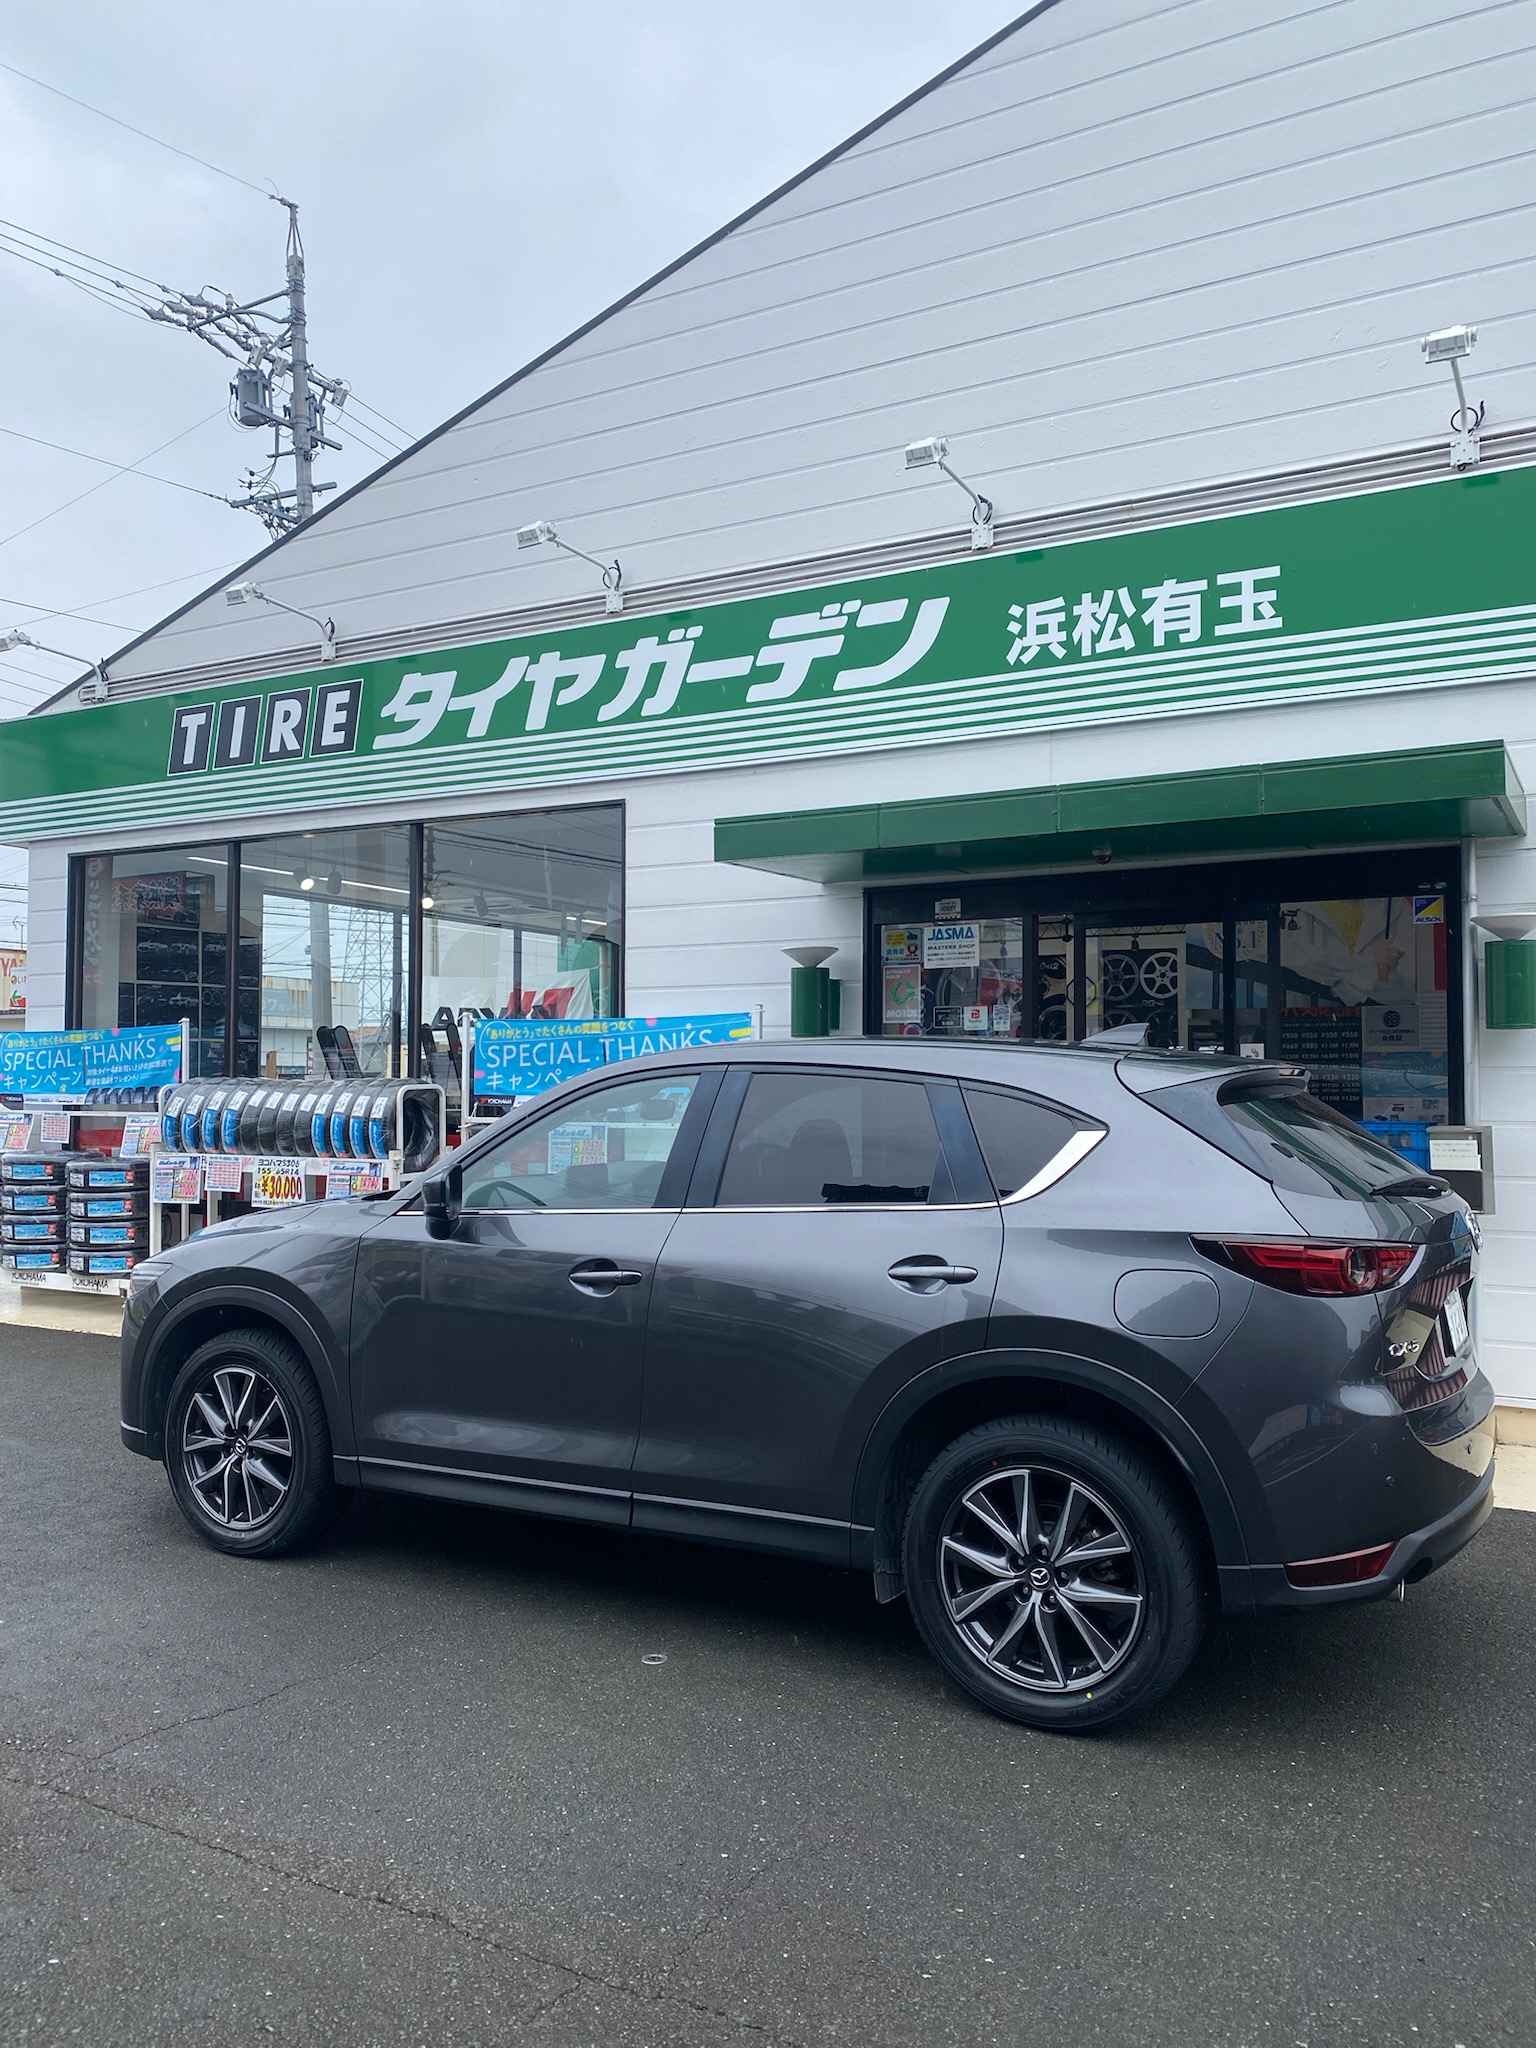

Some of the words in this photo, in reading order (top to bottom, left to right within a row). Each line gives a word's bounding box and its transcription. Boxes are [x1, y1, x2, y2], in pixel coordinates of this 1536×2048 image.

[180, 689, 351, 765] TIRE
[372, 596, 951, 750] タイヤガーデン
[1005, 565, 1284, 666] 浜松有玉
[927, 926, 975, 941] JASMA
[886, 1009, 918, 1018] MOTUL
[3, 1048, 76, 1072] SPECIAL
[81, 1037, 156, 1066] THANKS
[486, 1040, 591, 1069] SPECIAL
[3, 1070, 82, 1090] キャンペーン
[257, 1158, 300, 1168] ヨコハマS306
[261, 1175, 302, 1200] ¥30,000
[11, 1272, 47, 1283] YOKOHAMA
[72, 1277, 109, 1289] YOKOHAMA
[1388, 1338, 1420, 1358] CX-5
